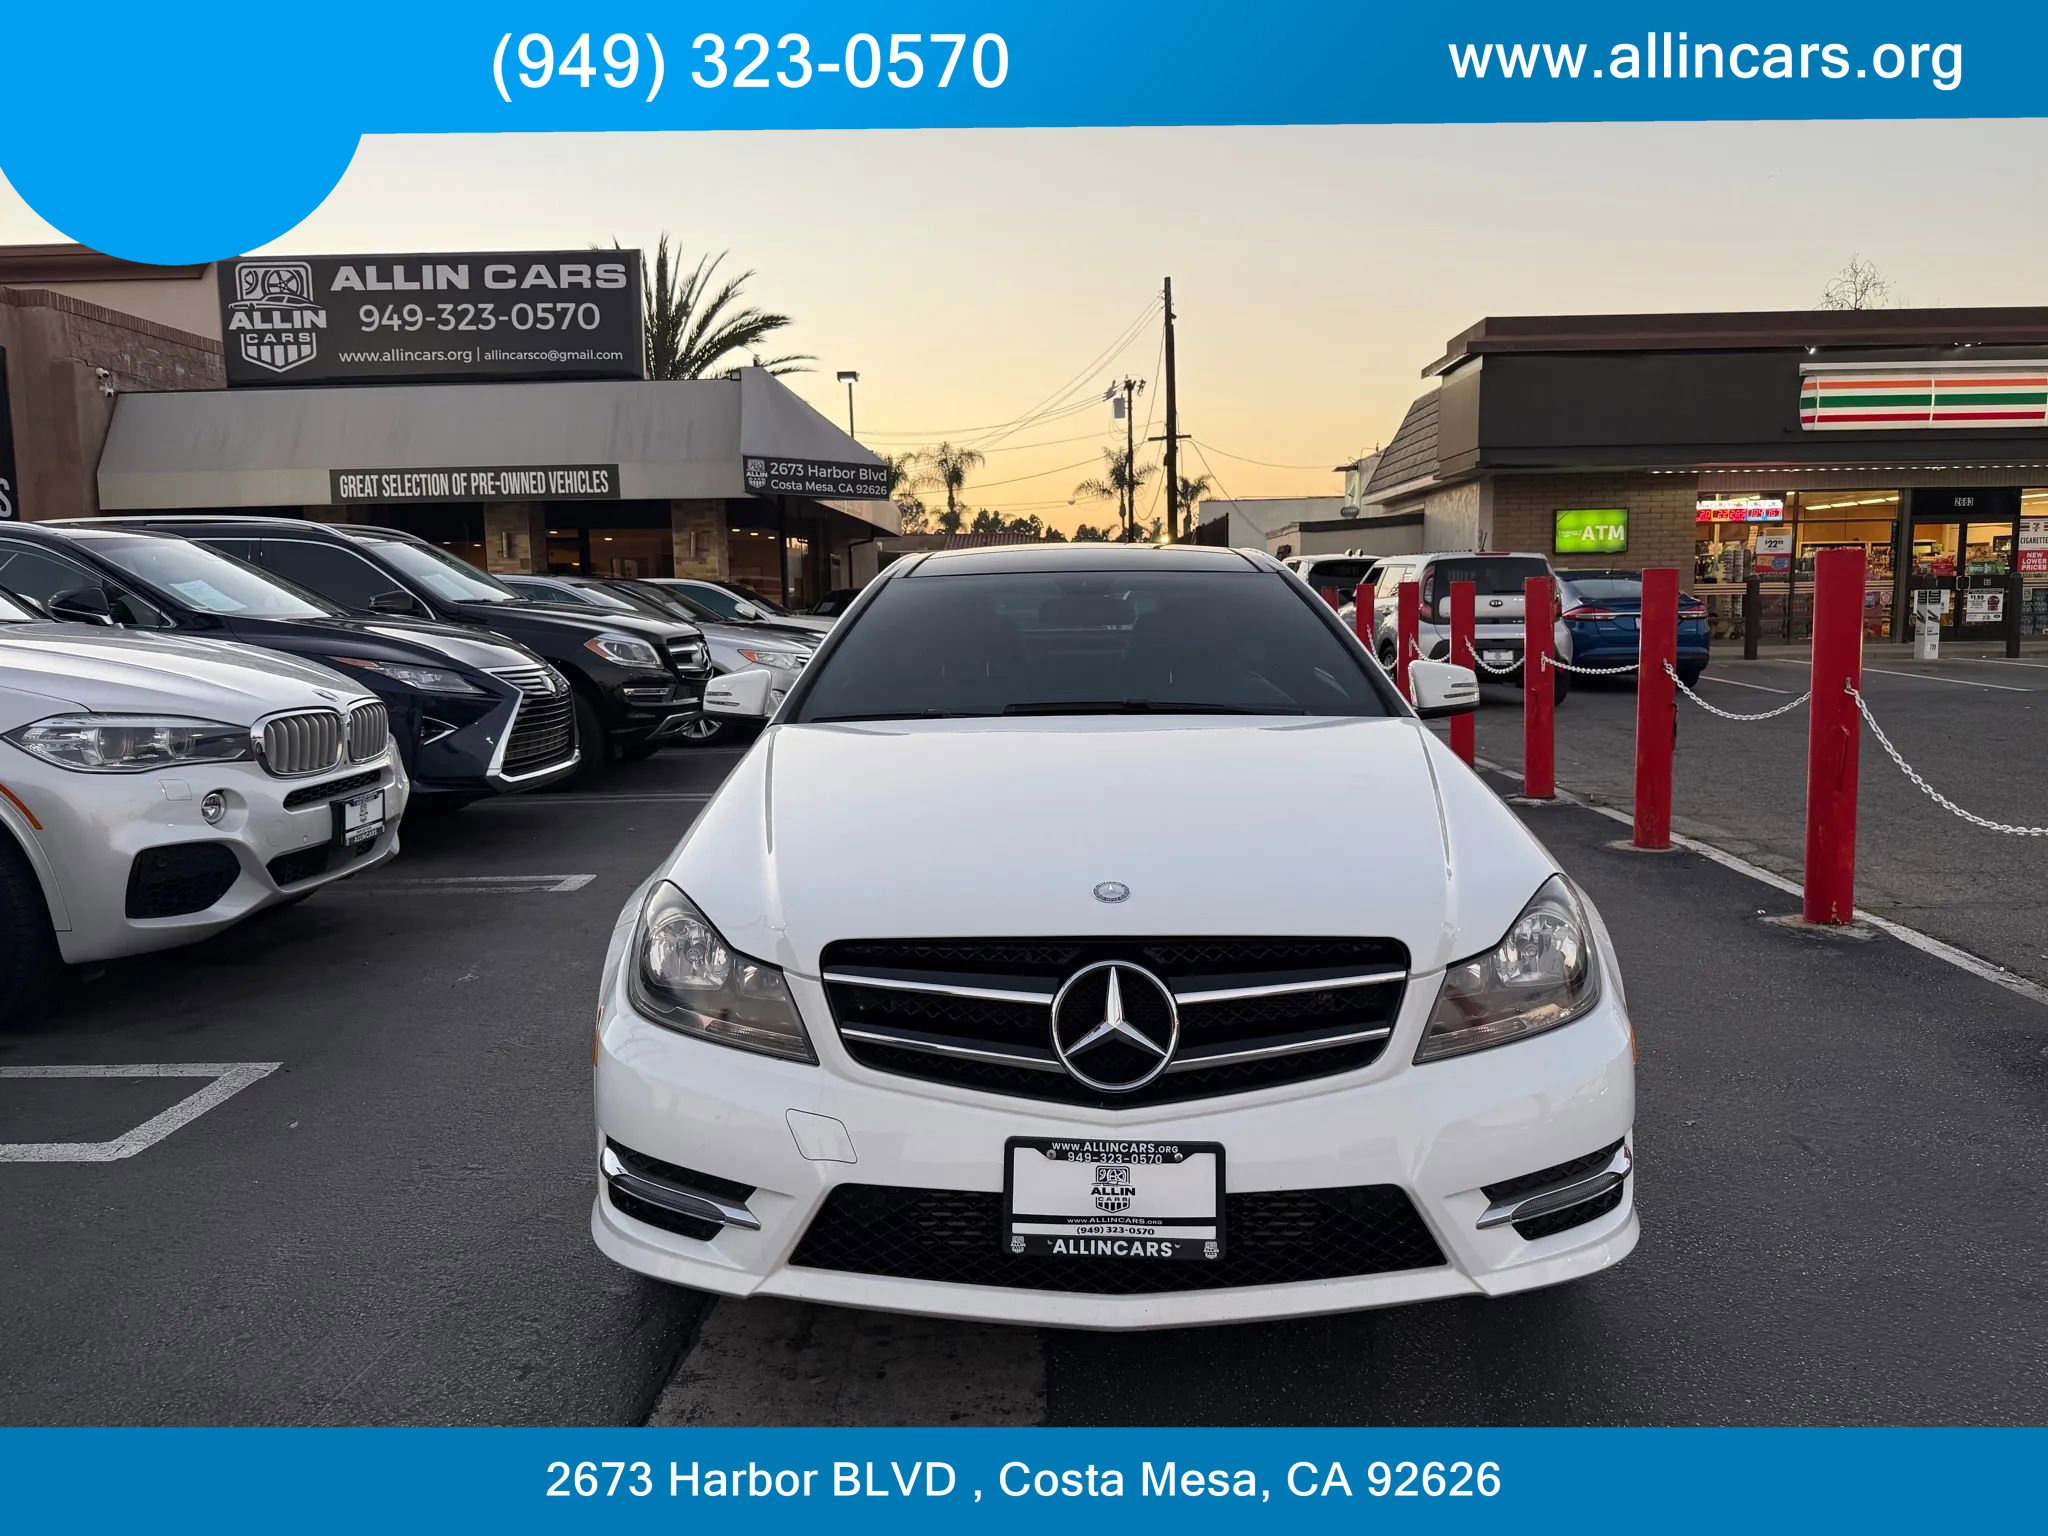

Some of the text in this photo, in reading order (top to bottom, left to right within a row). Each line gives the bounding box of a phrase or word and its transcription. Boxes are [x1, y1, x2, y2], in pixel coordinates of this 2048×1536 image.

[330, 263, 627, 291] ALLIN CARS
[228, 310, 328, 330] ALLIN
[359, 302, 601, 332] 949-323-0570
[246, 332, 312, 344] CARS
[338, 348, 624, 364] www.allincars.org allincarsco@gmail.com
[769, 462, 888, 482] 2673 Harbor Blvd
[339, 470, 610, 498] GREAT SELECTION OF PRE-OWNED VEHICLES
[770, 479, 888, 496] Costa Mesa, CA 92626
[1581, 525, 1625, 541] ATM
[1067, 1152, 1163, 1164] 949-323-0570
[1090, 1186, 1136, 1196] ALLIN
[1076, 1226, 1155, 1236] (949) 323-0570
[1053, 1239, 1173, 1257] ALLINCARS
